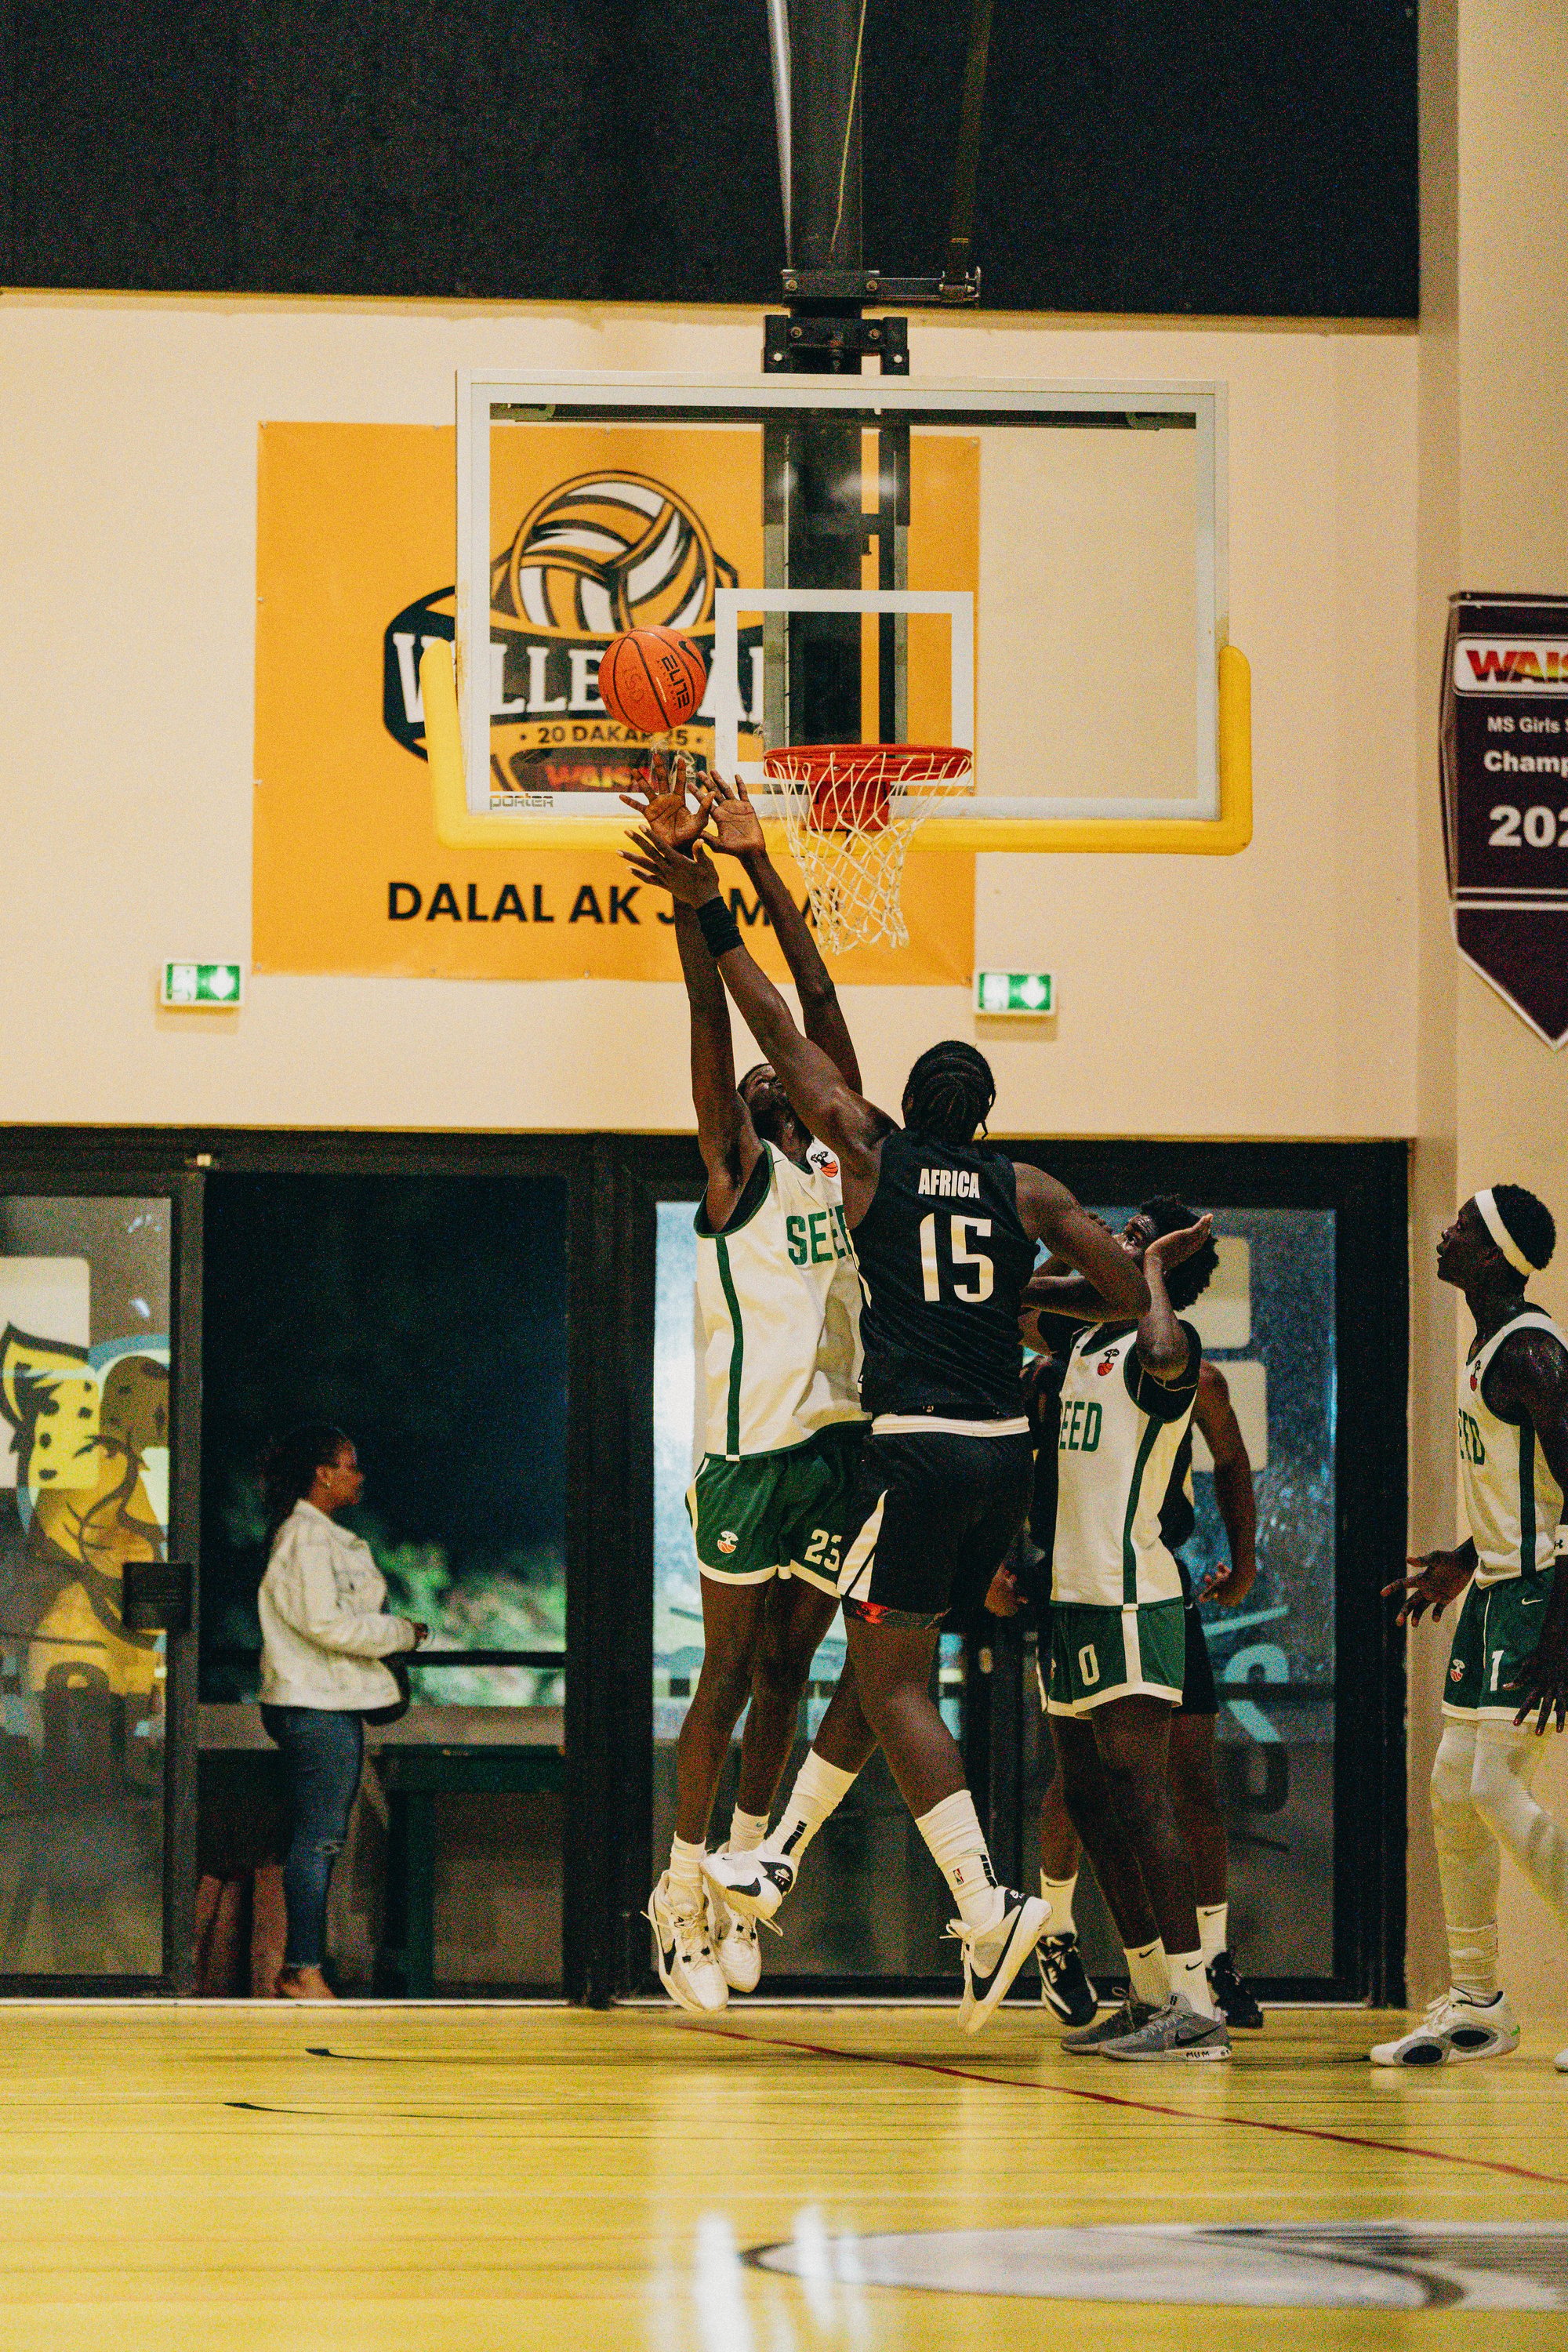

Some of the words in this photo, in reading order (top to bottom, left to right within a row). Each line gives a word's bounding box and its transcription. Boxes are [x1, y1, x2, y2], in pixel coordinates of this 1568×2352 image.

[662, 655, 690, 709] ELITE
[1466, 650, 1568, 682] WAI
[538, 727, 565, 743] 20
[1488, 716, 1515, 732] MS
[1519, 716, 1560, 733] Girls
[388, 882, 554, 923] DALAL
[568, 884, 641, 924] AK
[918, 1168, 980, 1199] AFRICA
[919, 1213, 994, 1302] 15
[804, 1529, 842, 1572] 23
[1079, 1644, 1099, 1686] 0
[1490, 1650, 1504, 1691] 1
